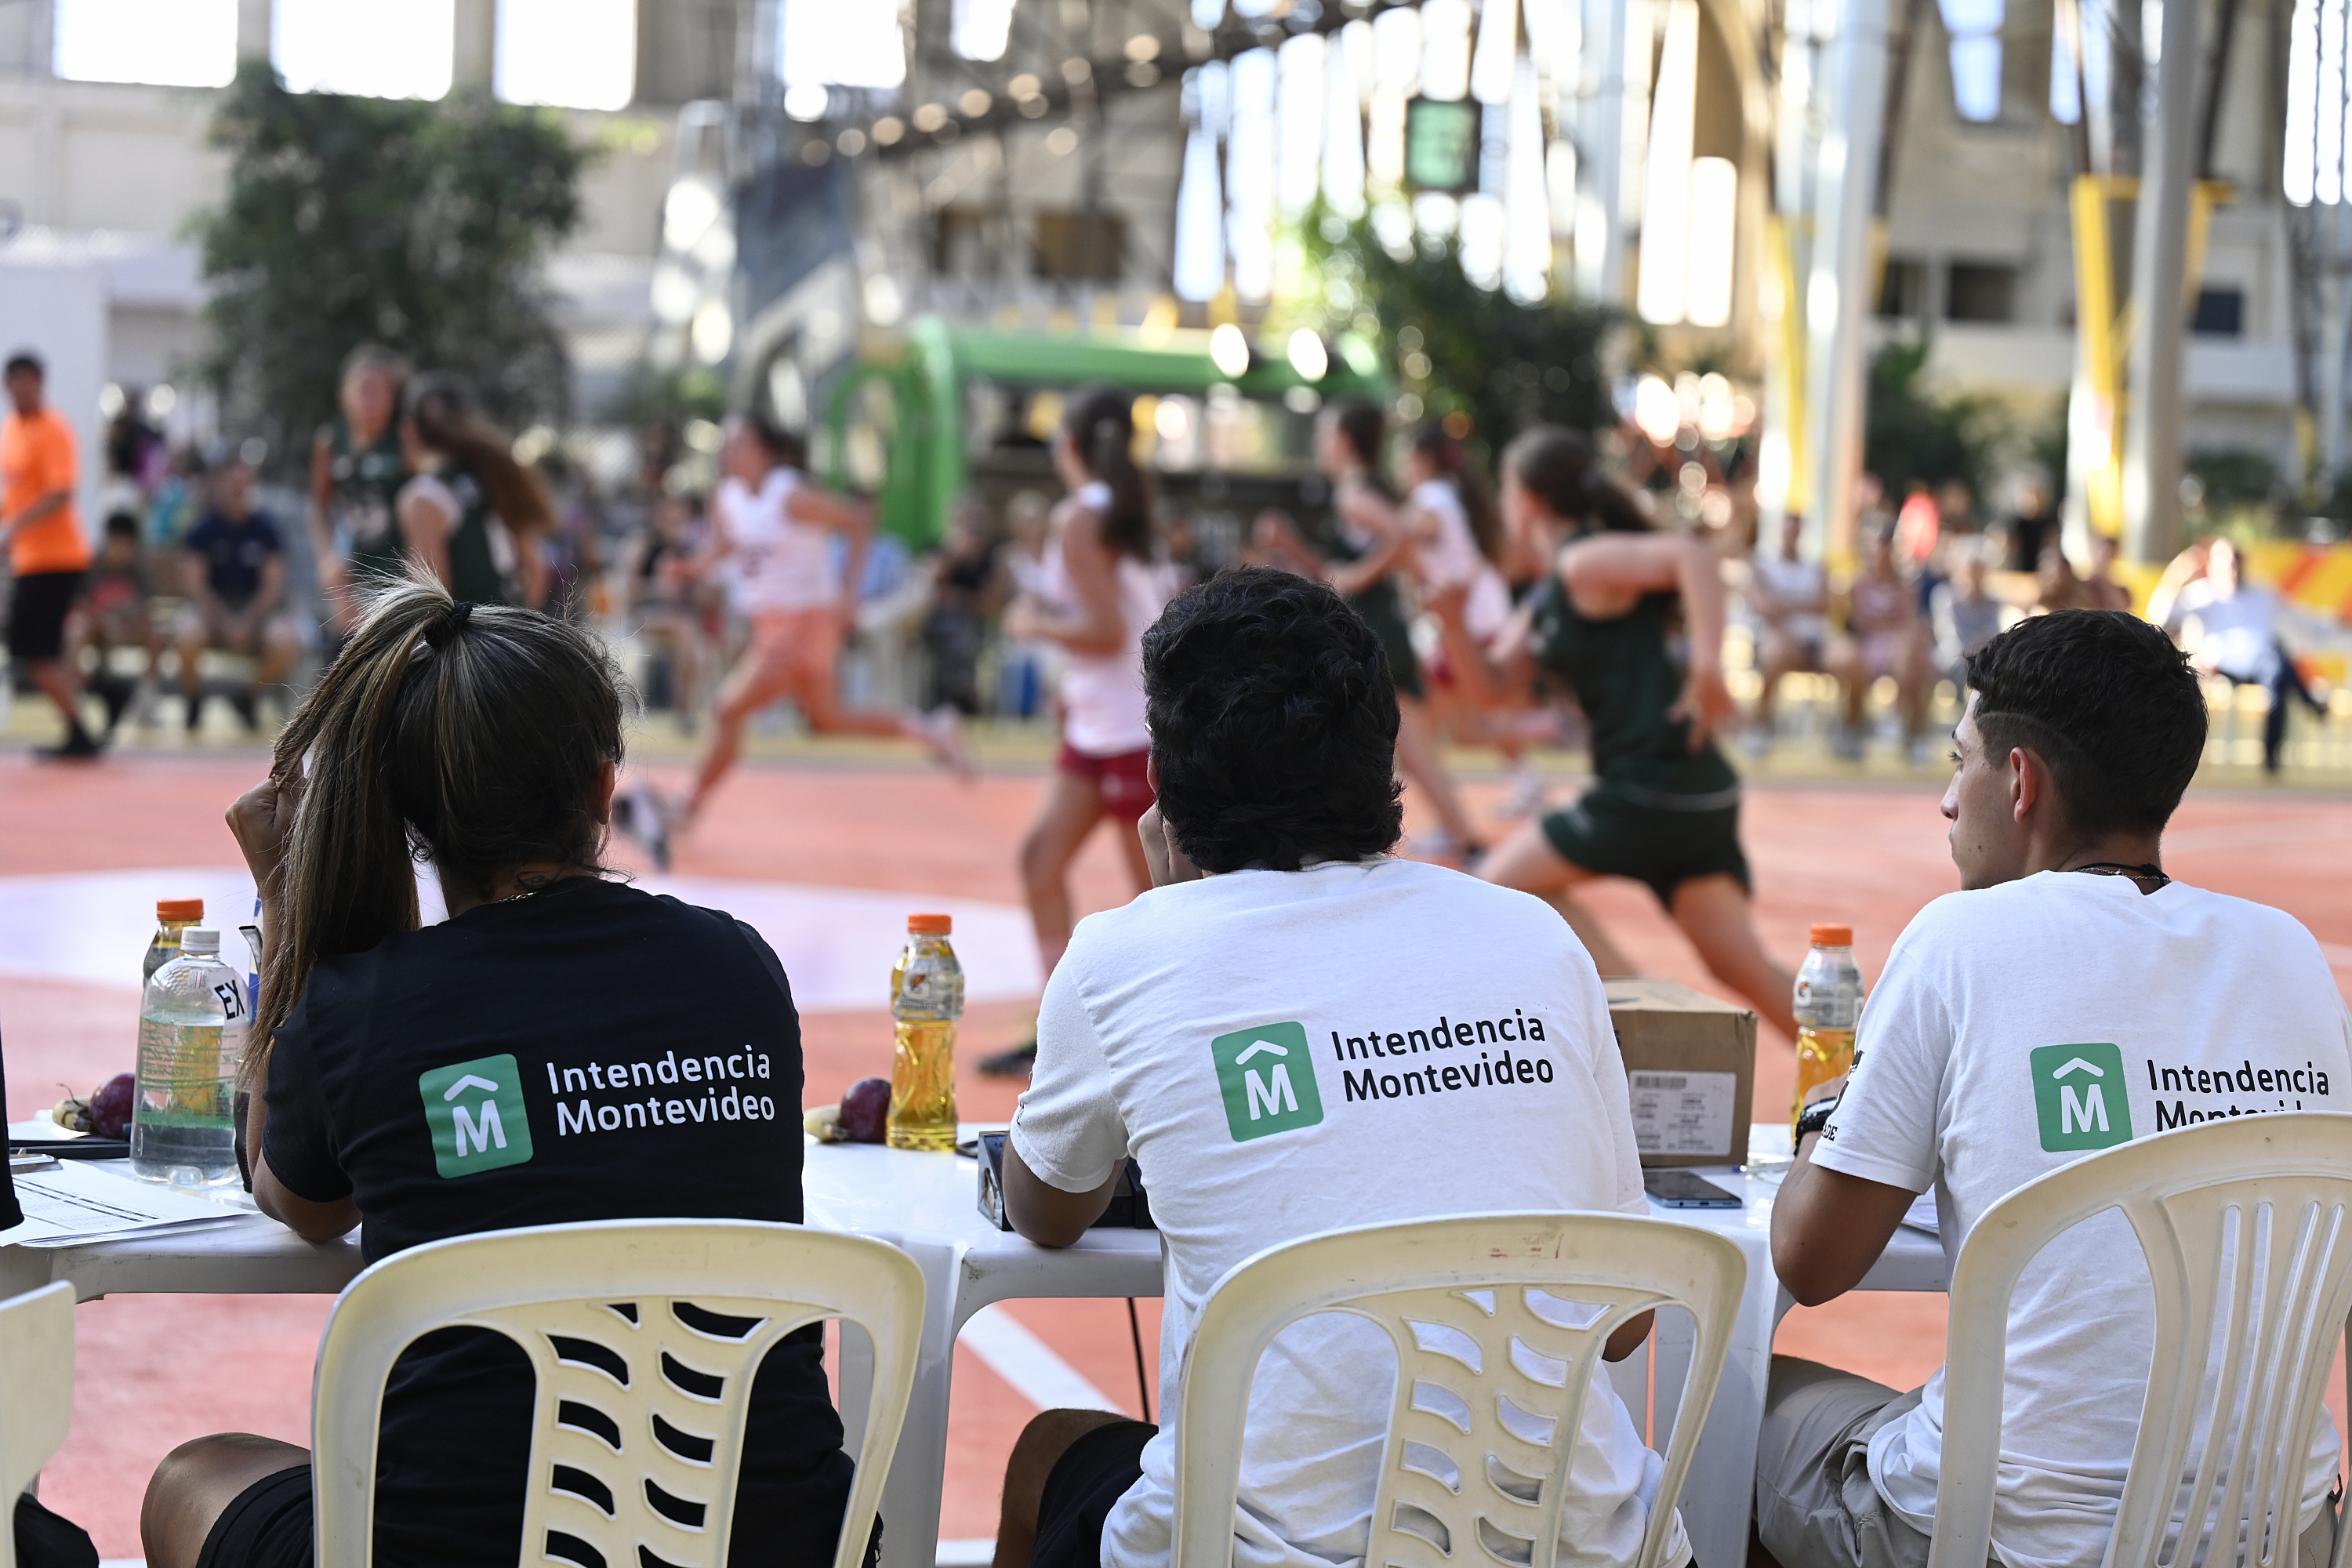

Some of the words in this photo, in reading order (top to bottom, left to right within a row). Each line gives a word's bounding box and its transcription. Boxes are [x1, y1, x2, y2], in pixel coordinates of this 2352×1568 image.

[214, 979, 245, 1020] EX
[1331, 1008, 1546, 1061] Intendencia
[546, 1044, 771, 1094] Intendencia
[1244, 1063, 1299, 1121] M
[1342, 1050, 1554, 1102] Montevideo
[2147, 1059, 2330, 1096] Intendencia
[452, 1099, 508, 1157] M
[556, 1086, 775, 1136] Montevideo
[2060, 1083, 2110, 1134] M
